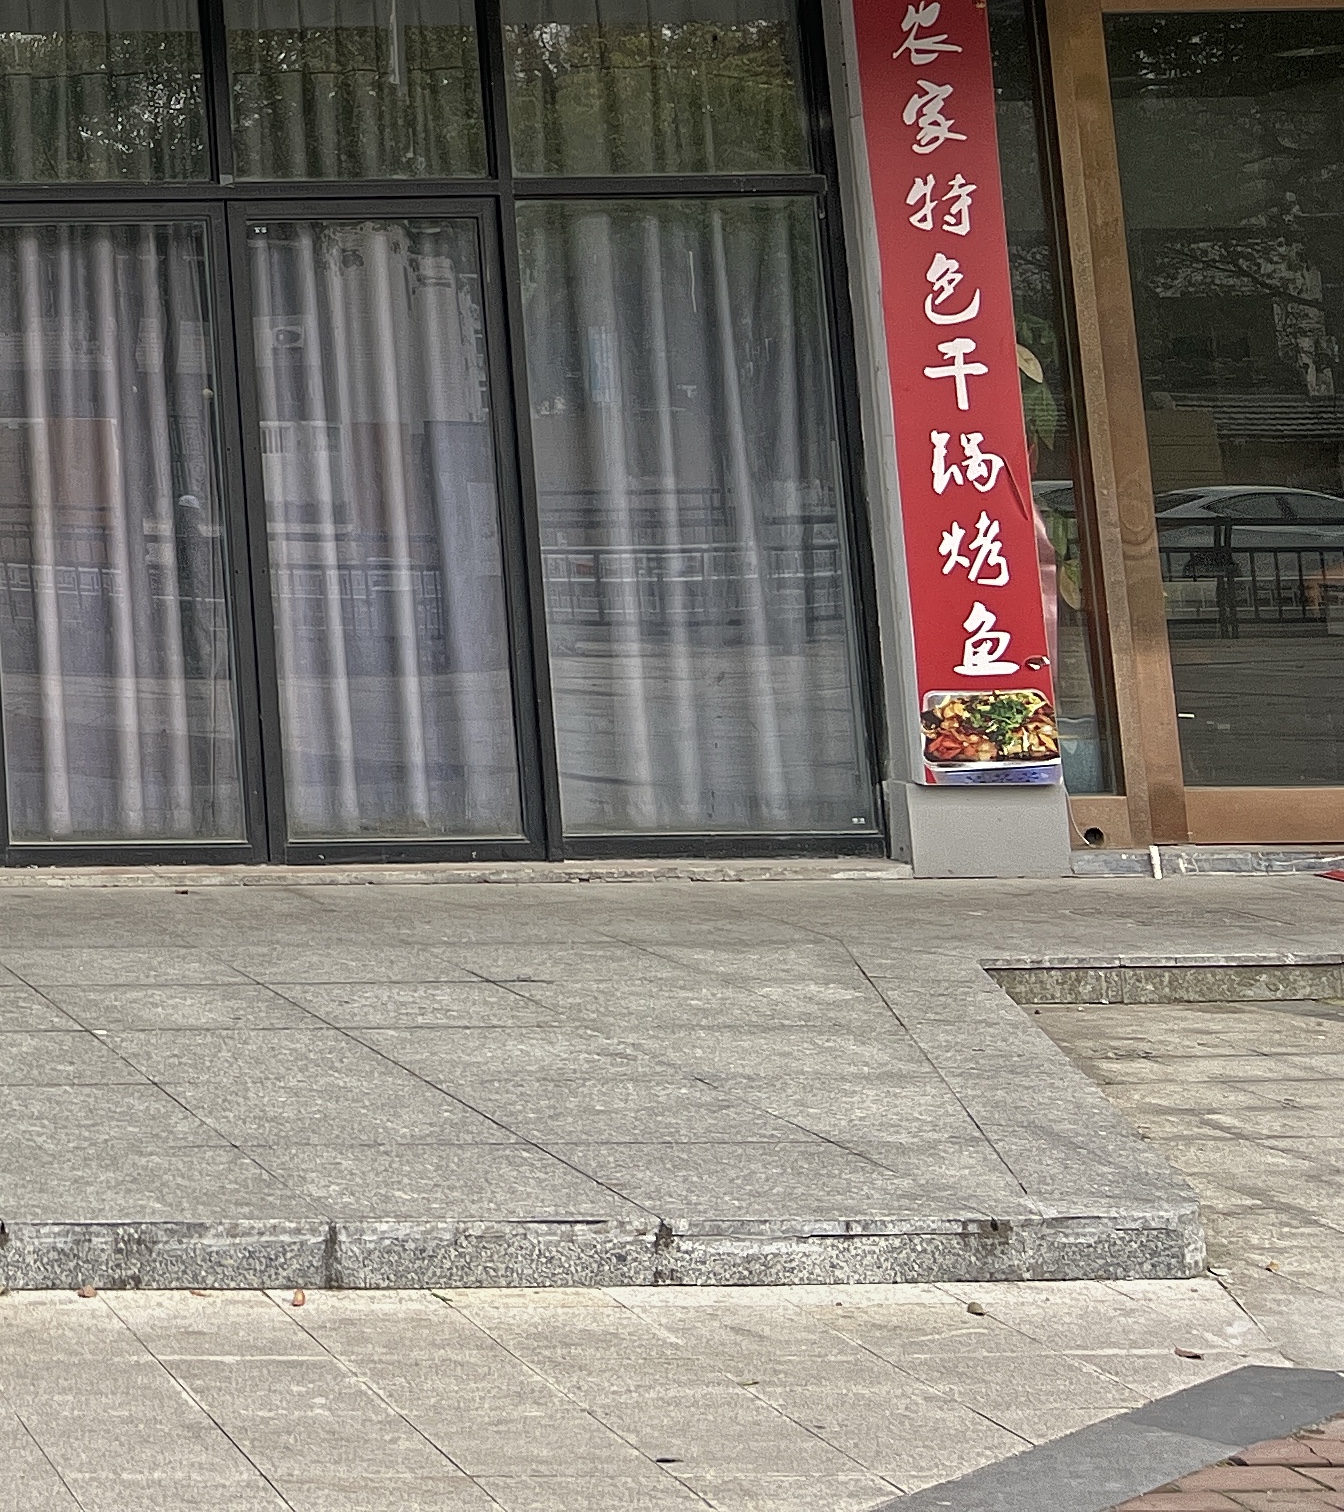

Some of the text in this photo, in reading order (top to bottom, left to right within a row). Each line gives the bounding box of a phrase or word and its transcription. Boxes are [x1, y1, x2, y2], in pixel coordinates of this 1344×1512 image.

[891, 0, 1021, 676] 农家特色干锅烤鱼
